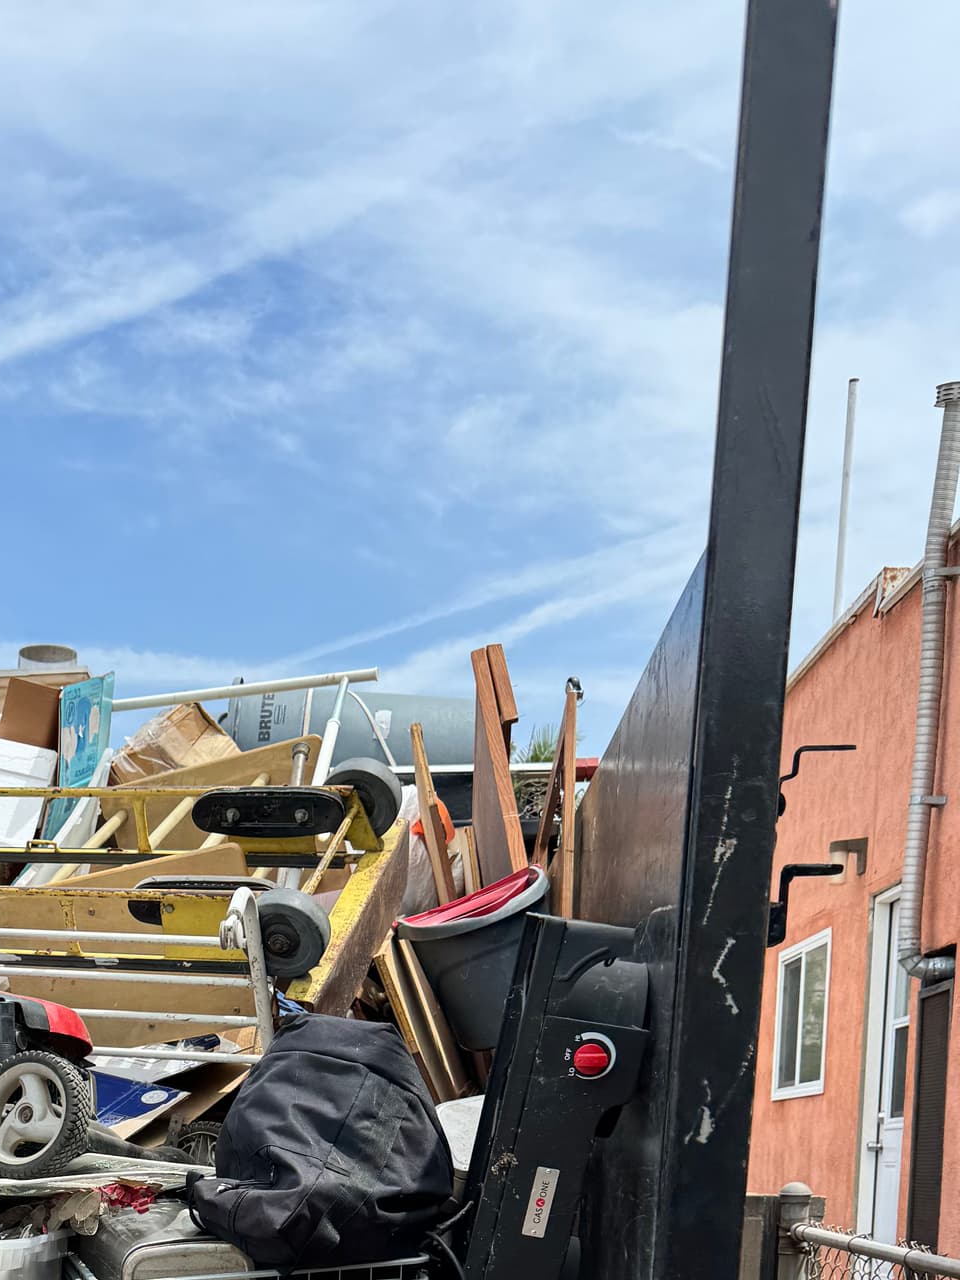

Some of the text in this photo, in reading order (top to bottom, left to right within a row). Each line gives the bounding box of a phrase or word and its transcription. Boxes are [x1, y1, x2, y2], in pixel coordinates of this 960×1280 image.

[257, 693, 276, 742] BRUTE
[533, 1180, 551, 1224] GAS ONE
